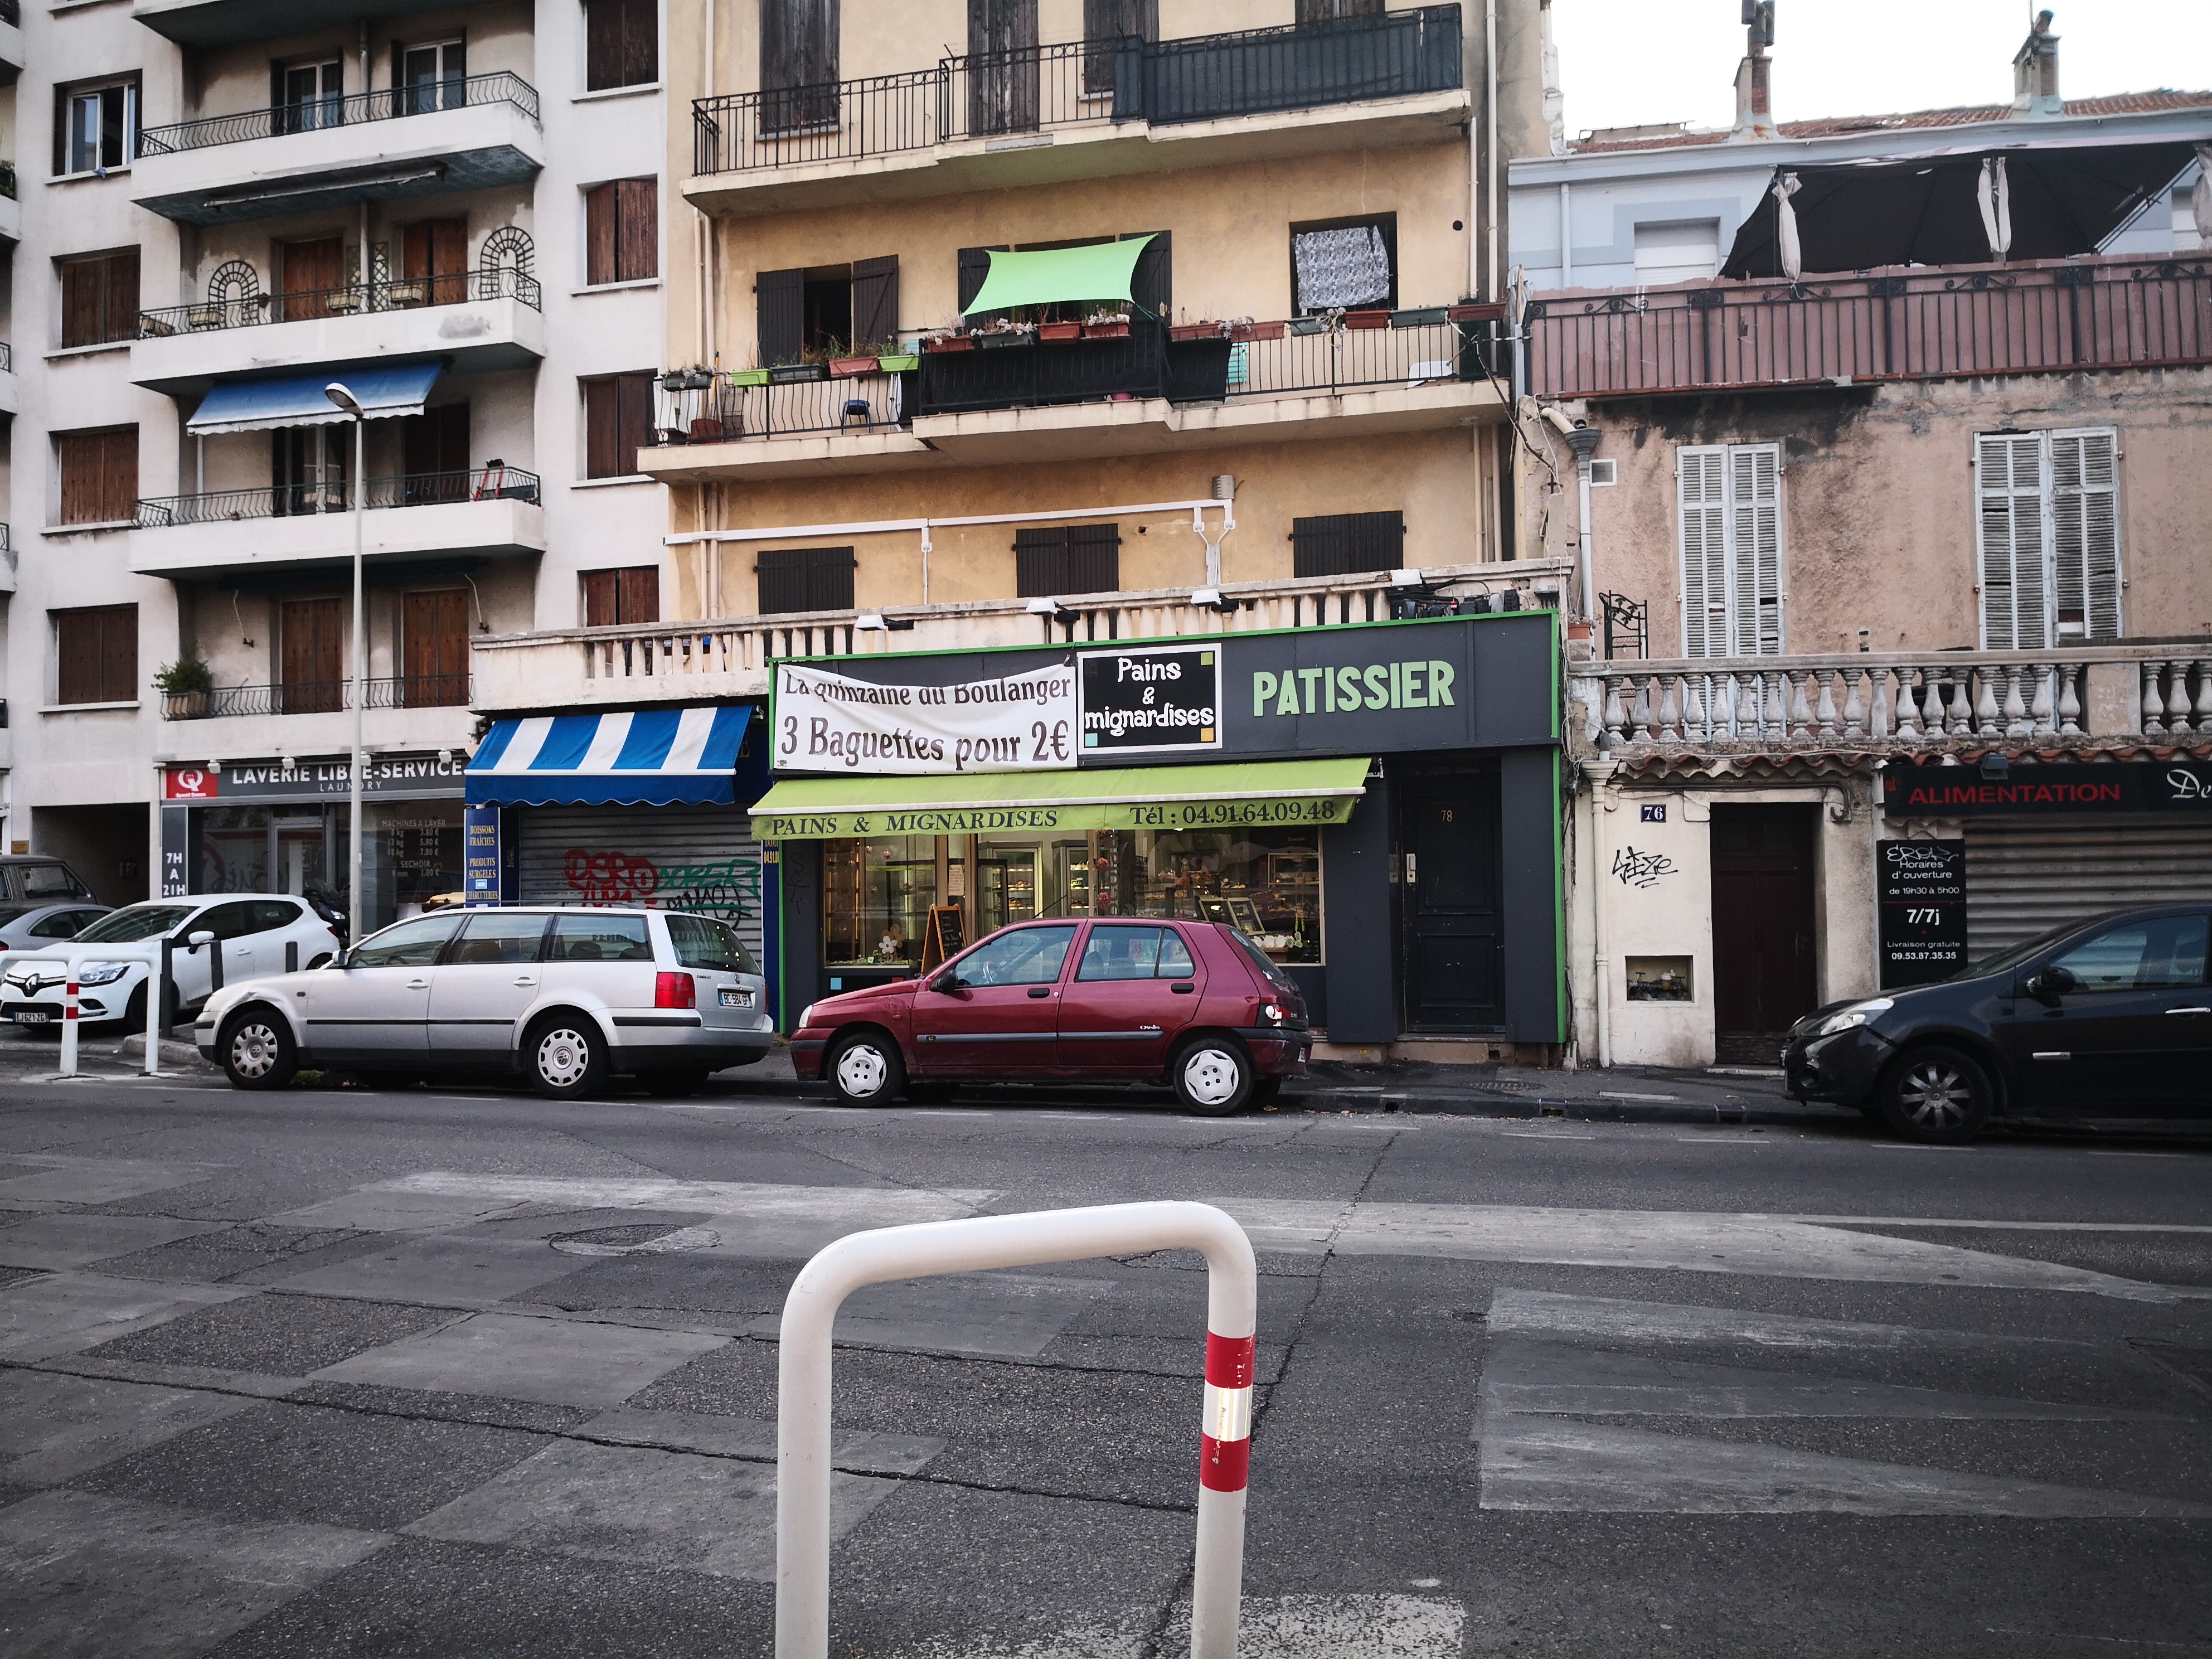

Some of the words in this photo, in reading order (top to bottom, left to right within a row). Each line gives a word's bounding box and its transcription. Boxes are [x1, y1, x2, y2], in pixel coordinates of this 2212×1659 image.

[1118, 657, 1181, 682] Pains
[785, 669, 810, 695] La
[814, 680, 911, 705] quinzaine
[919, 686, 947, 705] du
[955, 678, 1070, 706] Boulanger
[1142, 686, 1155, 705] &
[1253, 660, 1455, 717] PATISSIER
[1085, 702, 1214, 736] mignardises
[781, 716, 798, 754] 3
[808, 717, 944, 767] Baguettes
[955, 736, 1021, 771] pour
[1031, 720, 1069, 761] 2€
[232, 766, 311, 784] LAVERIE
[318, 760, 463, 781] LIBE-SERVICE
[320, 781, 382, 792] LAUNRY
[1909, 783, 2121, 804] ALIMENTATION
[772, 817, 837, 835] PAINS
[853, 817, 871, 833] &
[885, 810, 1058, 831] MIGNARDISES
[1129, 806, 1164, 826] Tél
[1182, 801, 1335, 824] 04.91.64.09.48
[1441, 810, 1453, 822] 78
[1644, 807, 1663, 820] 76
[469, 825, 495, 835] BOISSONS
[166, 852, 183, 864] 7H
[469, 857, 496, 867] PRODUITS
[1900, 860, 1944, 869] Horaires
[169, 868, 179, 880] A
[163, 884, 186, 896] 21H
[1907, 908, 1939, 925] 7/7j
